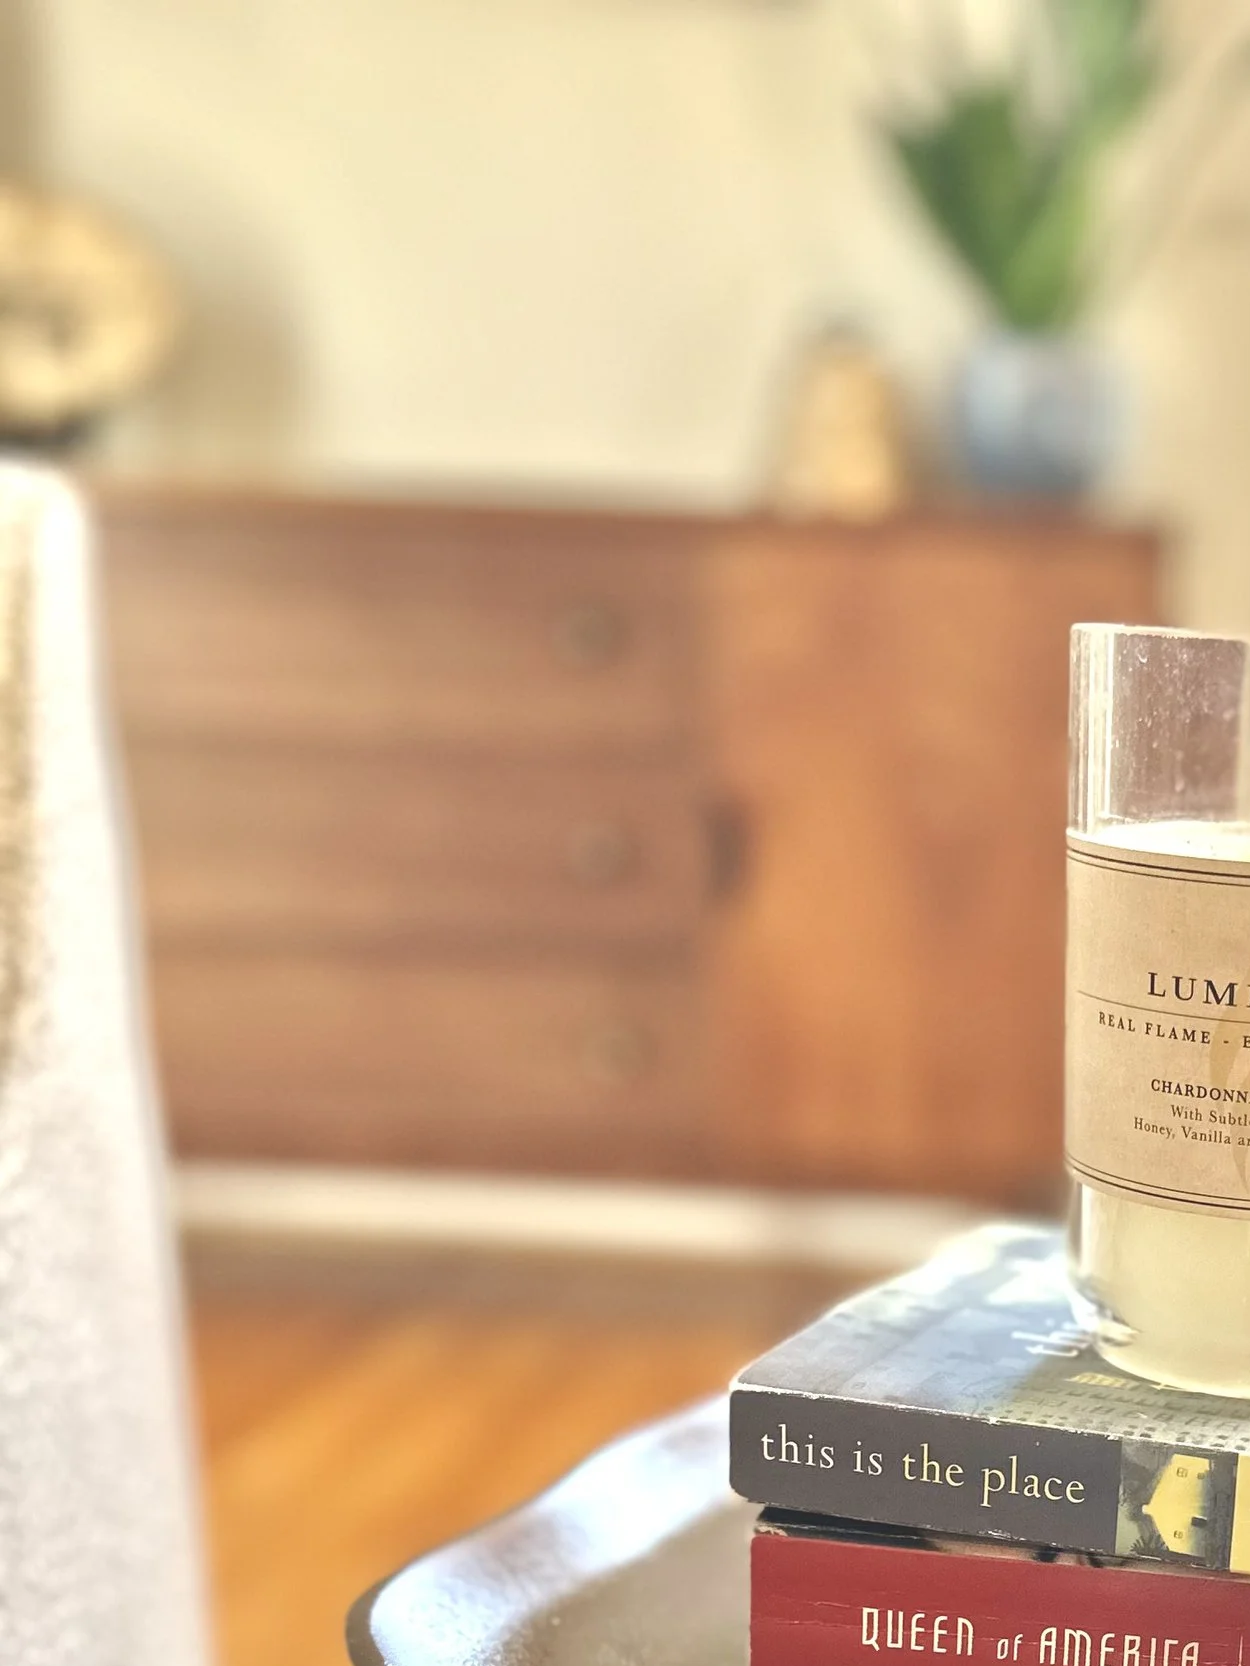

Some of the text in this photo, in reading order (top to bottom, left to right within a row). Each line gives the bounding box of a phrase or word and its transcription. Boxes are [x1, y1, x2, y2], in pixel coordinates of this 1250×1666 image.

[1098, 1011, 1136, 1033] REAL
[1145, 1022, 1211, 1045] FLAME
[1133, 1115, 1176, 1140] Honey,
[1181, 1125, 1231, 1145] Vanilla
[1170, 1104, 1203, 1122] With
[760, 1424, 1086, 1508] this is the place
[861, 1607, 975, 1656] QUEEN
[996, 1633, 1023, 1662] of
